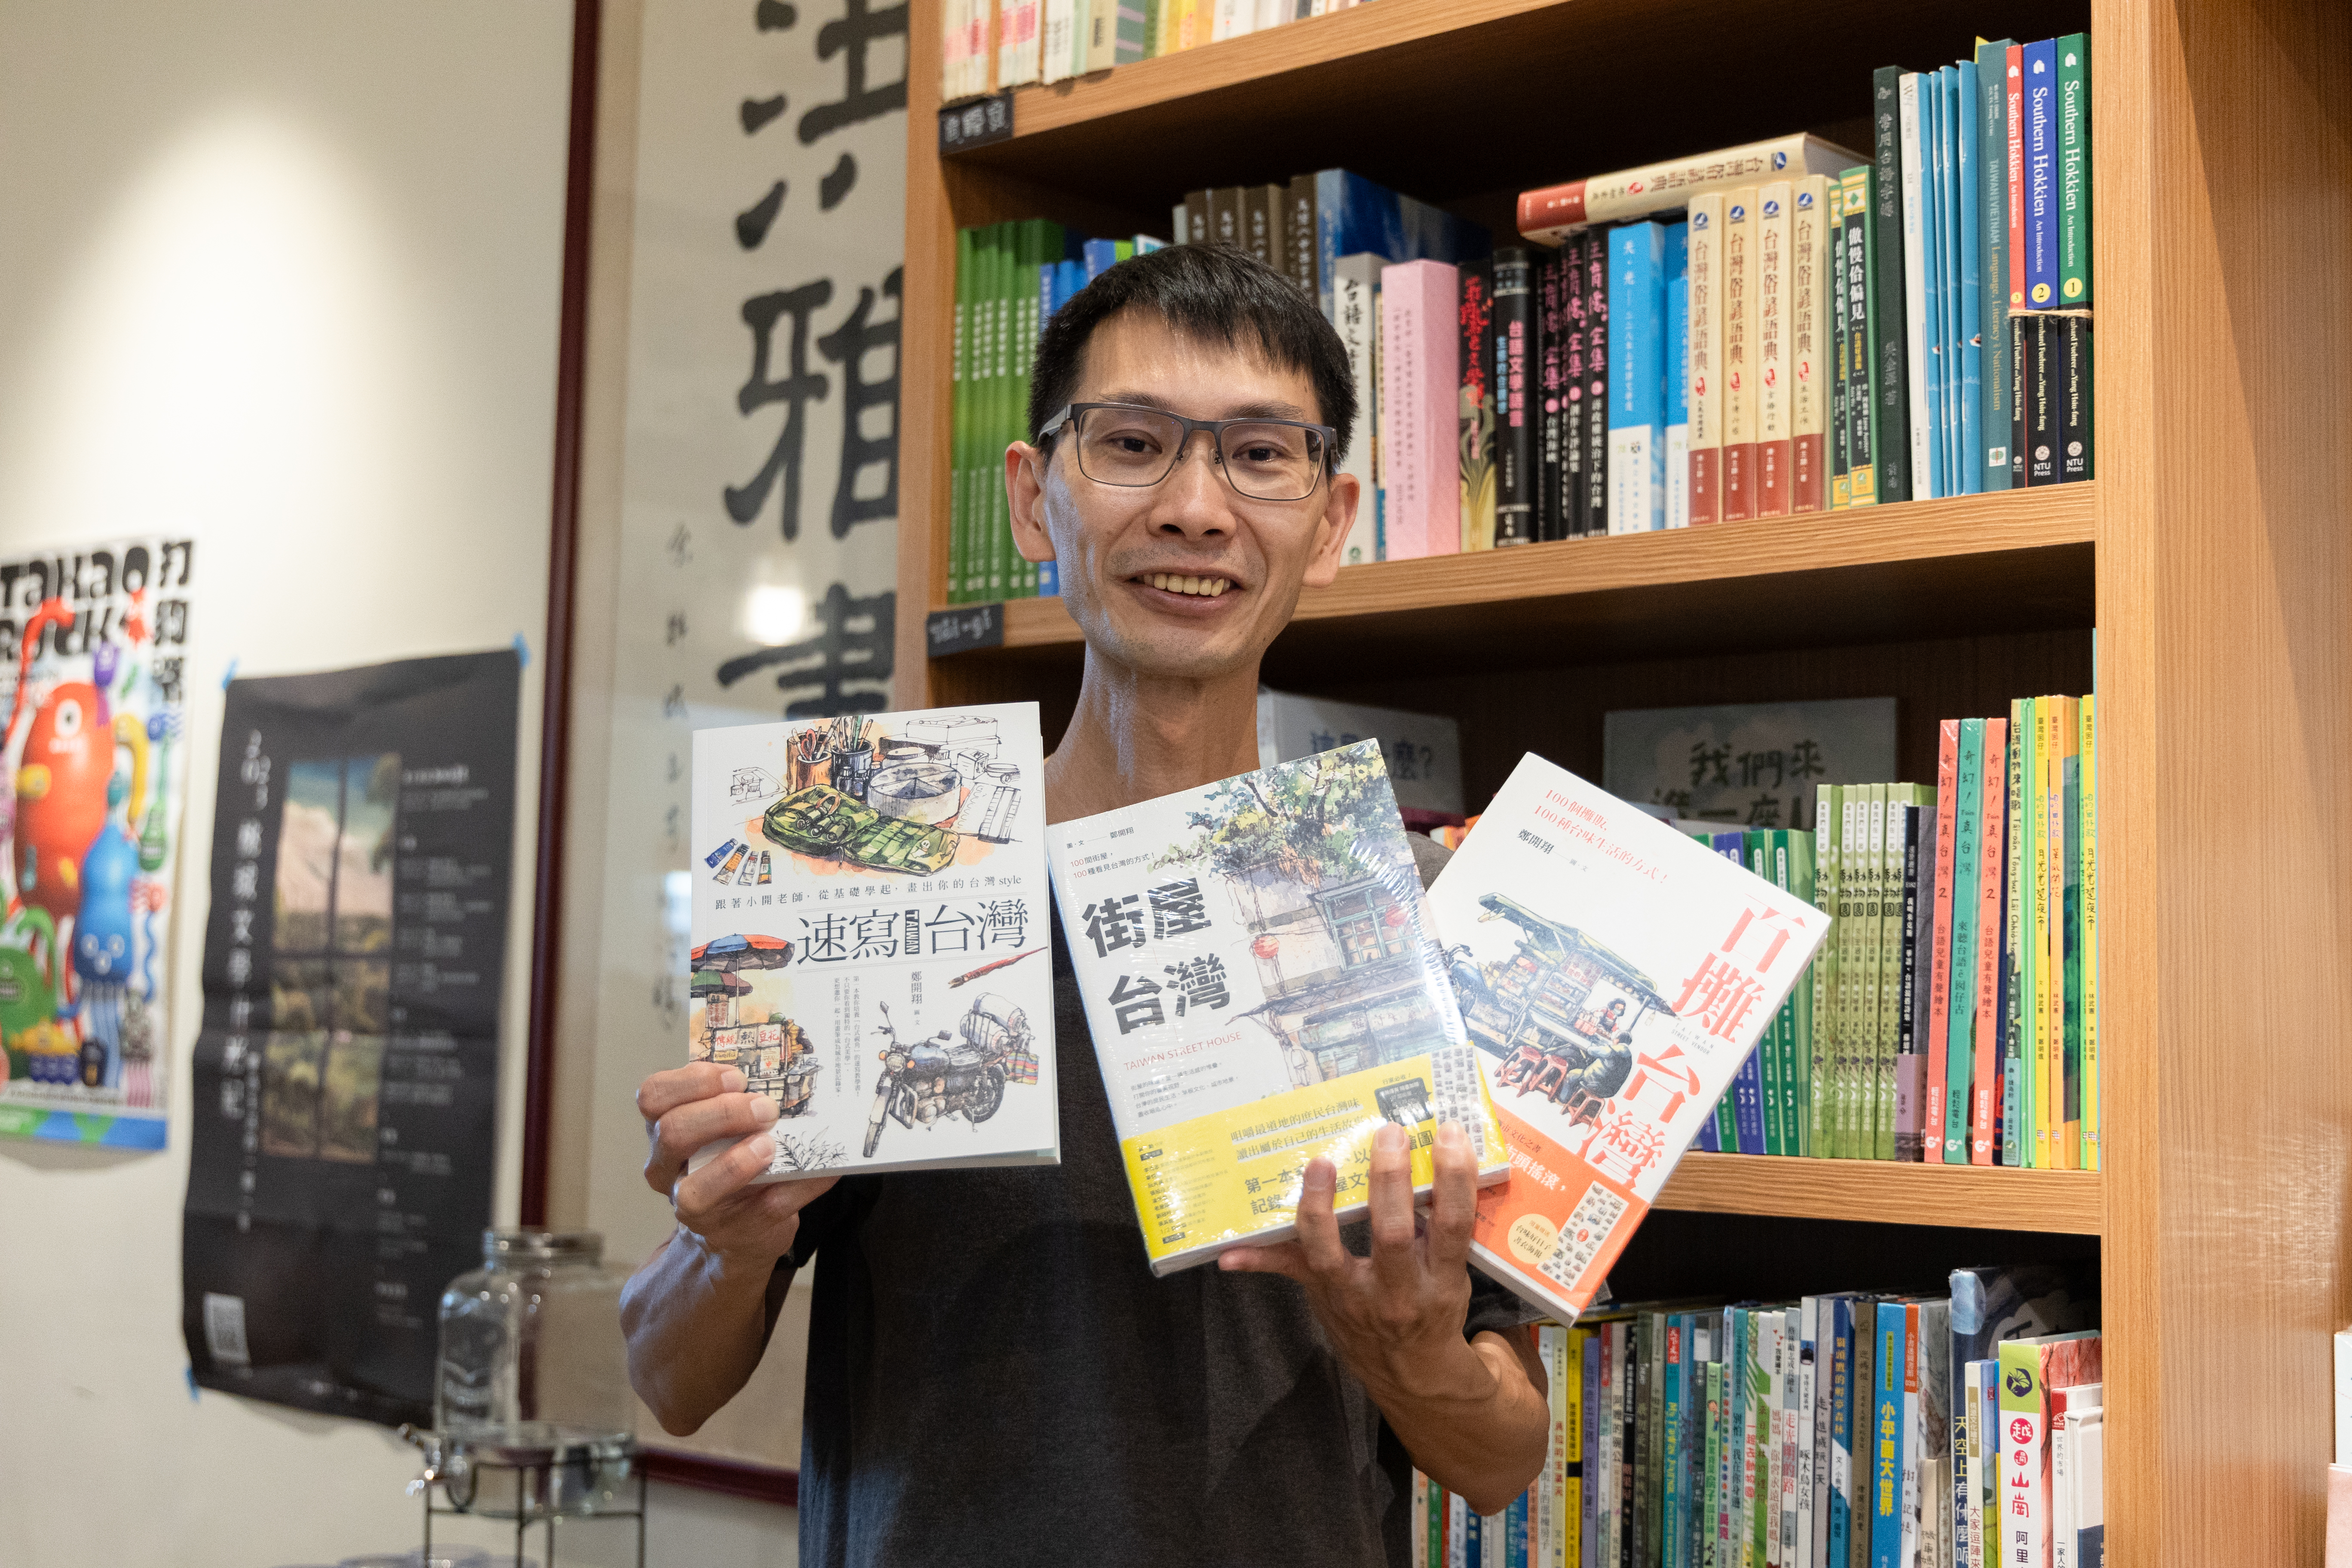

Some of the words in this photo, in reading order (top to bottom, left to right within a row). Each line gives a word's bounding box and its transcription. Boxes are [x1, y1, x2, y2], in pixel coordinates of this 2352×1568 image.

[2009, 93, 2019, 138] Southern
[2033, 87, 2048, 152] Southern
[2065, 80, 2080, 145] Southern
[1989, 158, 1999, 196] TAIWAN
[2009, 138, 2020, 182] Hokkien
[2065, 147, 2081, 211] Hokkien
[2033, 153, 2049, 217] Hokkien
[1990, 199, 2001, 244] VIETNAM
[1693, 239, 1709, 372] 台灣俗諺語典
[1729, 232, 1744, 365] 台灣俗諺語典
[1762, 228, 1779, 363] 台灣俗諺語典
[1796, 219, 1812, 355] 台灣俗諺語典
[2037, 288, 2045, 298] 2
[2070, 283, 2076, 293] 1
[2070, 316, 2078, 341] ernhard
[2034, 462, 2051, 471] NTU
[2067, 458, 2083, 467] NTU
[1689, 738, 1825, 789] 我們來
[1109, 827, 1134, 839] 鄭開翔
[1516, 828, 1555, 854] 鄭開翔
[1533, 805, 1668, 884] 100種台味生活的方式！
[1070, 852, 1113, 867] 100間街屋，
[1073, 852, 1155, 879] 100種看見台灣的方式！
[1939, 888, 1948, 899] 2
[1986, 888, 1996, 899] 2
[796, 907, 900, 966] 速寫
[905, 909, 920, 955] TAIWAN
[924, 898, 1029, 955] 台灣
[1081, 877, 1212, 959] 街屋
[911, 971, 922, 1004] 鄭開翔
[1933, 924, 1945, 1017] 台語兒童有聲繪本
[1982, 925, 1994, 1019] 台語兒童有聲繪本
[1108, 952, 1231, 1036] 台灣
[715, 1029, 737, 1048] 傳統
[740, 1031, 755, 1044] 熱
[759, 1029, 780, 1043] 豆花
[1124, 1053, 1165, 1071] TAIWAN
[1167, 1041, 1204, 1059] STREET
[1206, 1031, 1242, 1048] HOUSE
[1671, 1029, 1689, 1042] STREET
[1691, 1041, 1711, 1055] VENDOR
[1675, 1023, 1714, 1049] TAIWAN
[1230, 1097, 1361, 1143] 咀嚼最道地的庶民台灣味
[1236, 1115, 1365, 1161] 讀出屬於自己的生活故事
[1513, 1237, 1543, 1259] 書衣海報
[1515, 1225, 1552, 1251] 台味好日子
[1879, 1401, 1896, 1517] 小平面大世界
[2056, 1436, 2064, 1476] 世界的市場
[1799, 1449, 1811, 1511] 啄木鳥女孩
[1970, 1506, 1981, 1568] 大家逗陣來
[2015, 1531, 2029, 1568] 阿里
